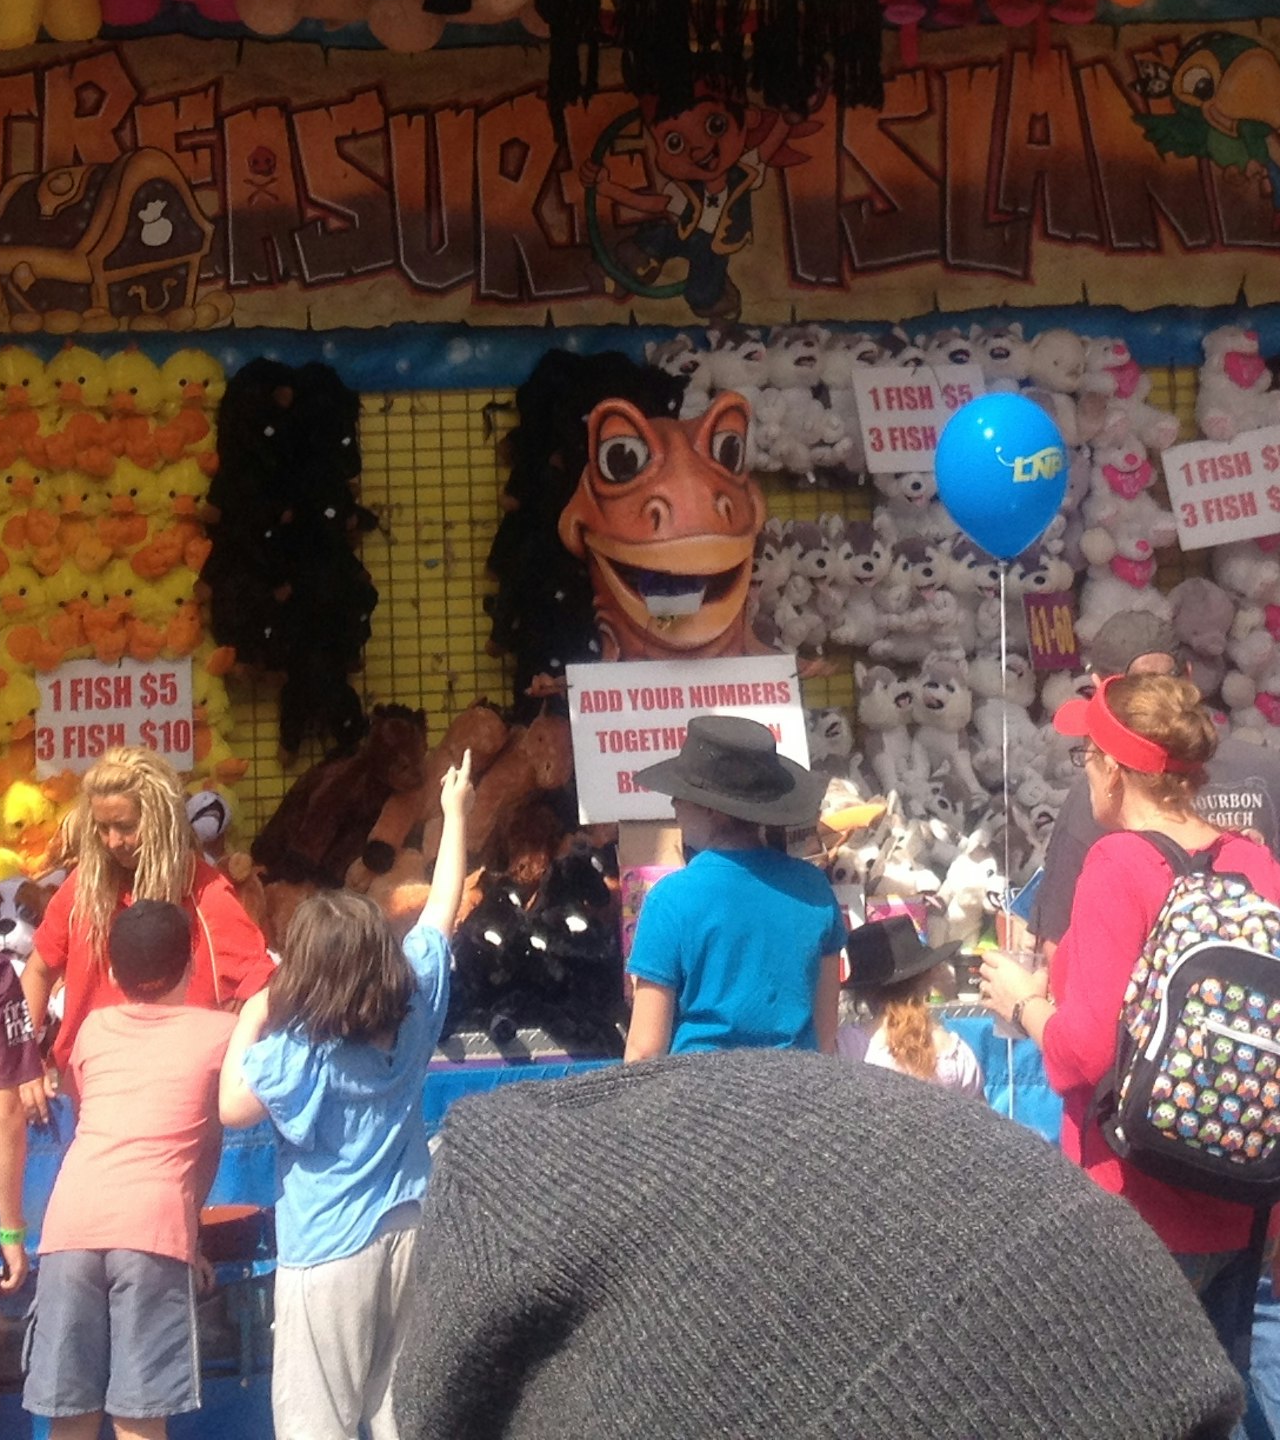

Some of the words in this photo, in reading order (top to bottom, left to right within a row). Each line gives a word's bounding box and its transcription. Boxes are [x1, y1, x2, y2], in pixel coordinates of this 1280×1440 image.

[869, 387, 880, 410] 1
[884, 385, 934, 410] FISH
[869, 427, 883, 452] 3
[888, 425, 937, 451] FISH
[1179, 462, 1194, 487] 1
[1197, 451, 1253, 483] FISH
[1180, 502, 1198, 528] 3
[1202, 491, 1258, 524] FISH
[48, 679, 62, 711] 1
[70, 675, 132, 711] FISH
[139, 672, 178, 709] $5
[580, 688, 623, 714] ADD
[627, 685, 684, 712] YOUR
[689, 681, 791, 708] NUMBERS
[37, 727, 55, 760] 3
[63, 723, 125, 759] FISH
[139, 719, 191, 754] $10
[596, 726, 687, 754] TOGETHE
